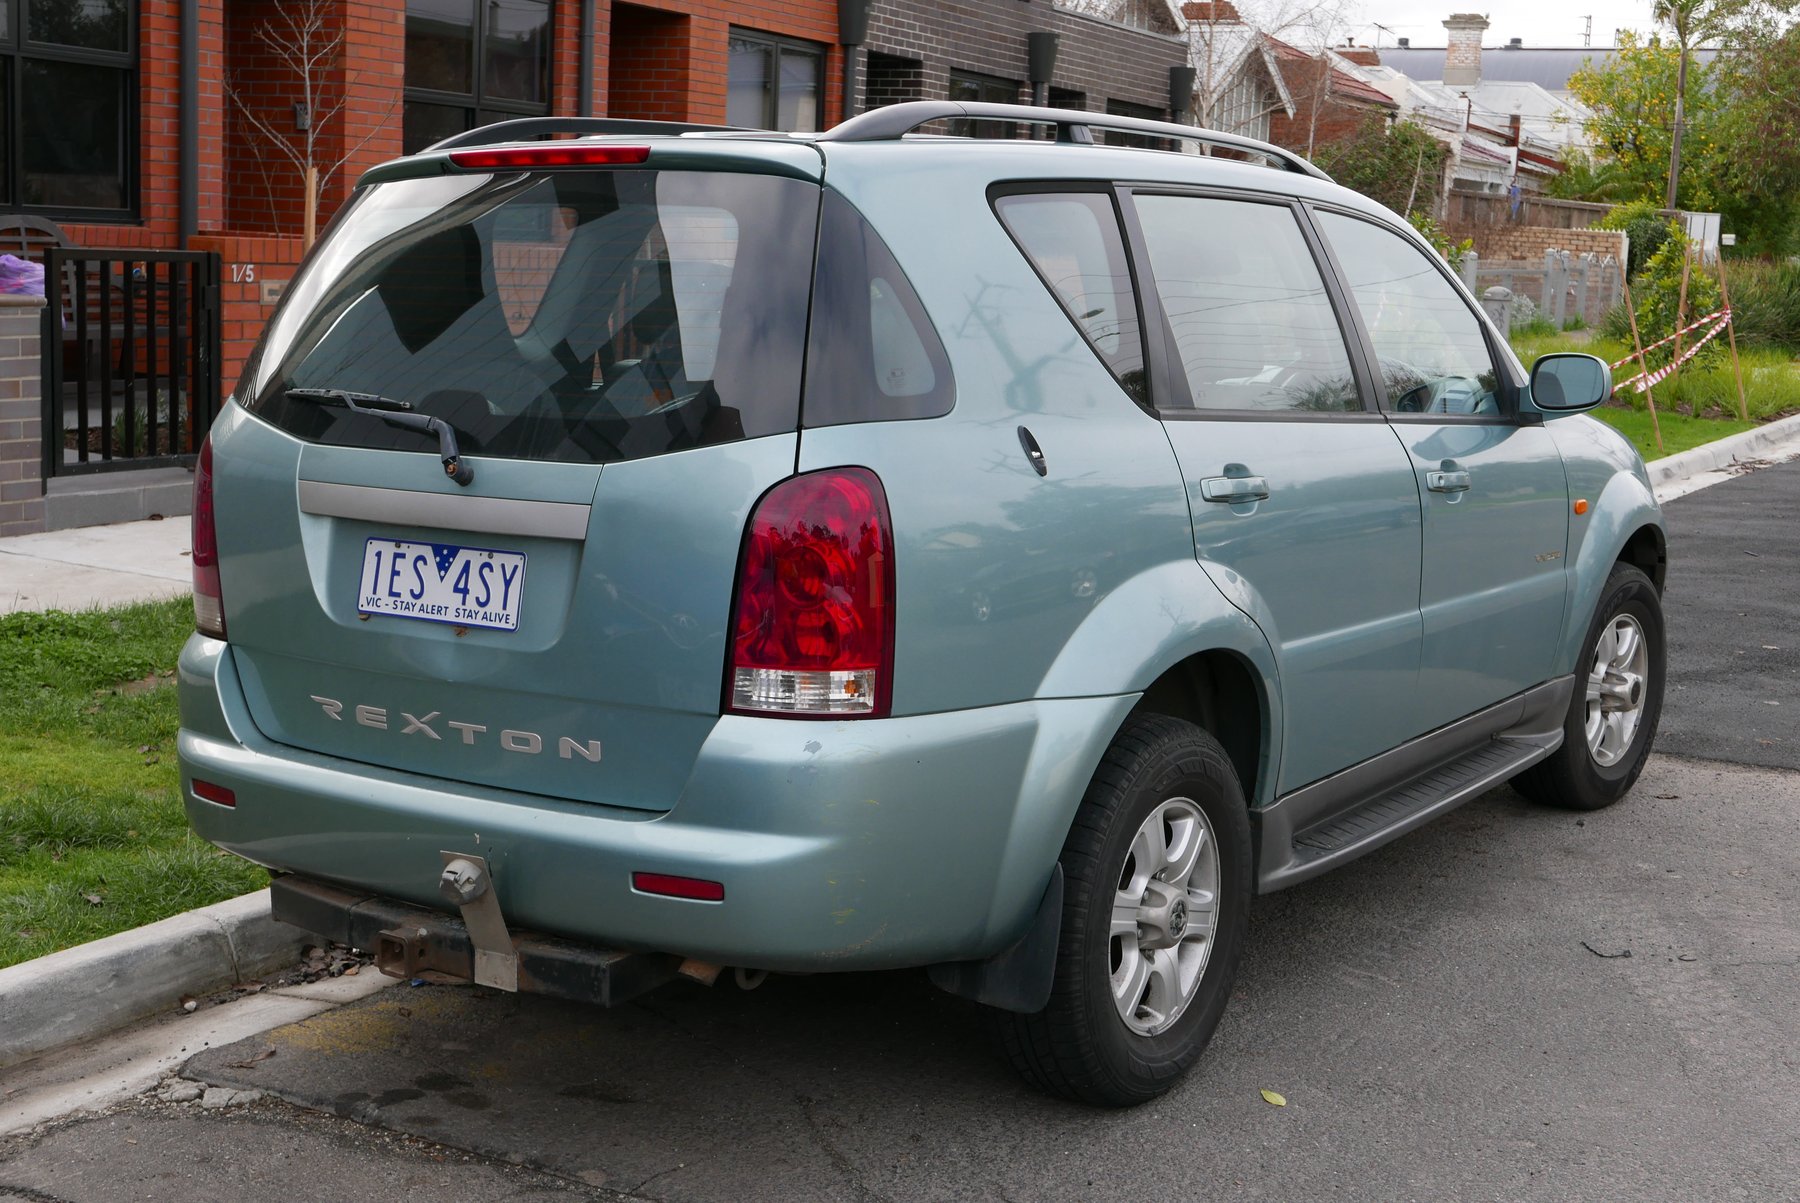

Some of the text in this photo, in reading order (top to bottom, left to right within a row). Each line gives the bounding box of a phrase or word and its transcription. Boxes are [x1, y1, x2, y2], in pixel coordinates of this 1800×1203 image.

[231, 264, 254, 282] 1/5
[373, 550, 519, 611] 1ES 4SY
[365, 596, 382, 608] VIC
[392, 600, 417, 613] STAY
[418, 603, 449, 617] ALERT
[454, 607, 479, 620] STAY
[481, 611, 511, 624] ALIVE
[310, 695, 601, 762] REXTON
